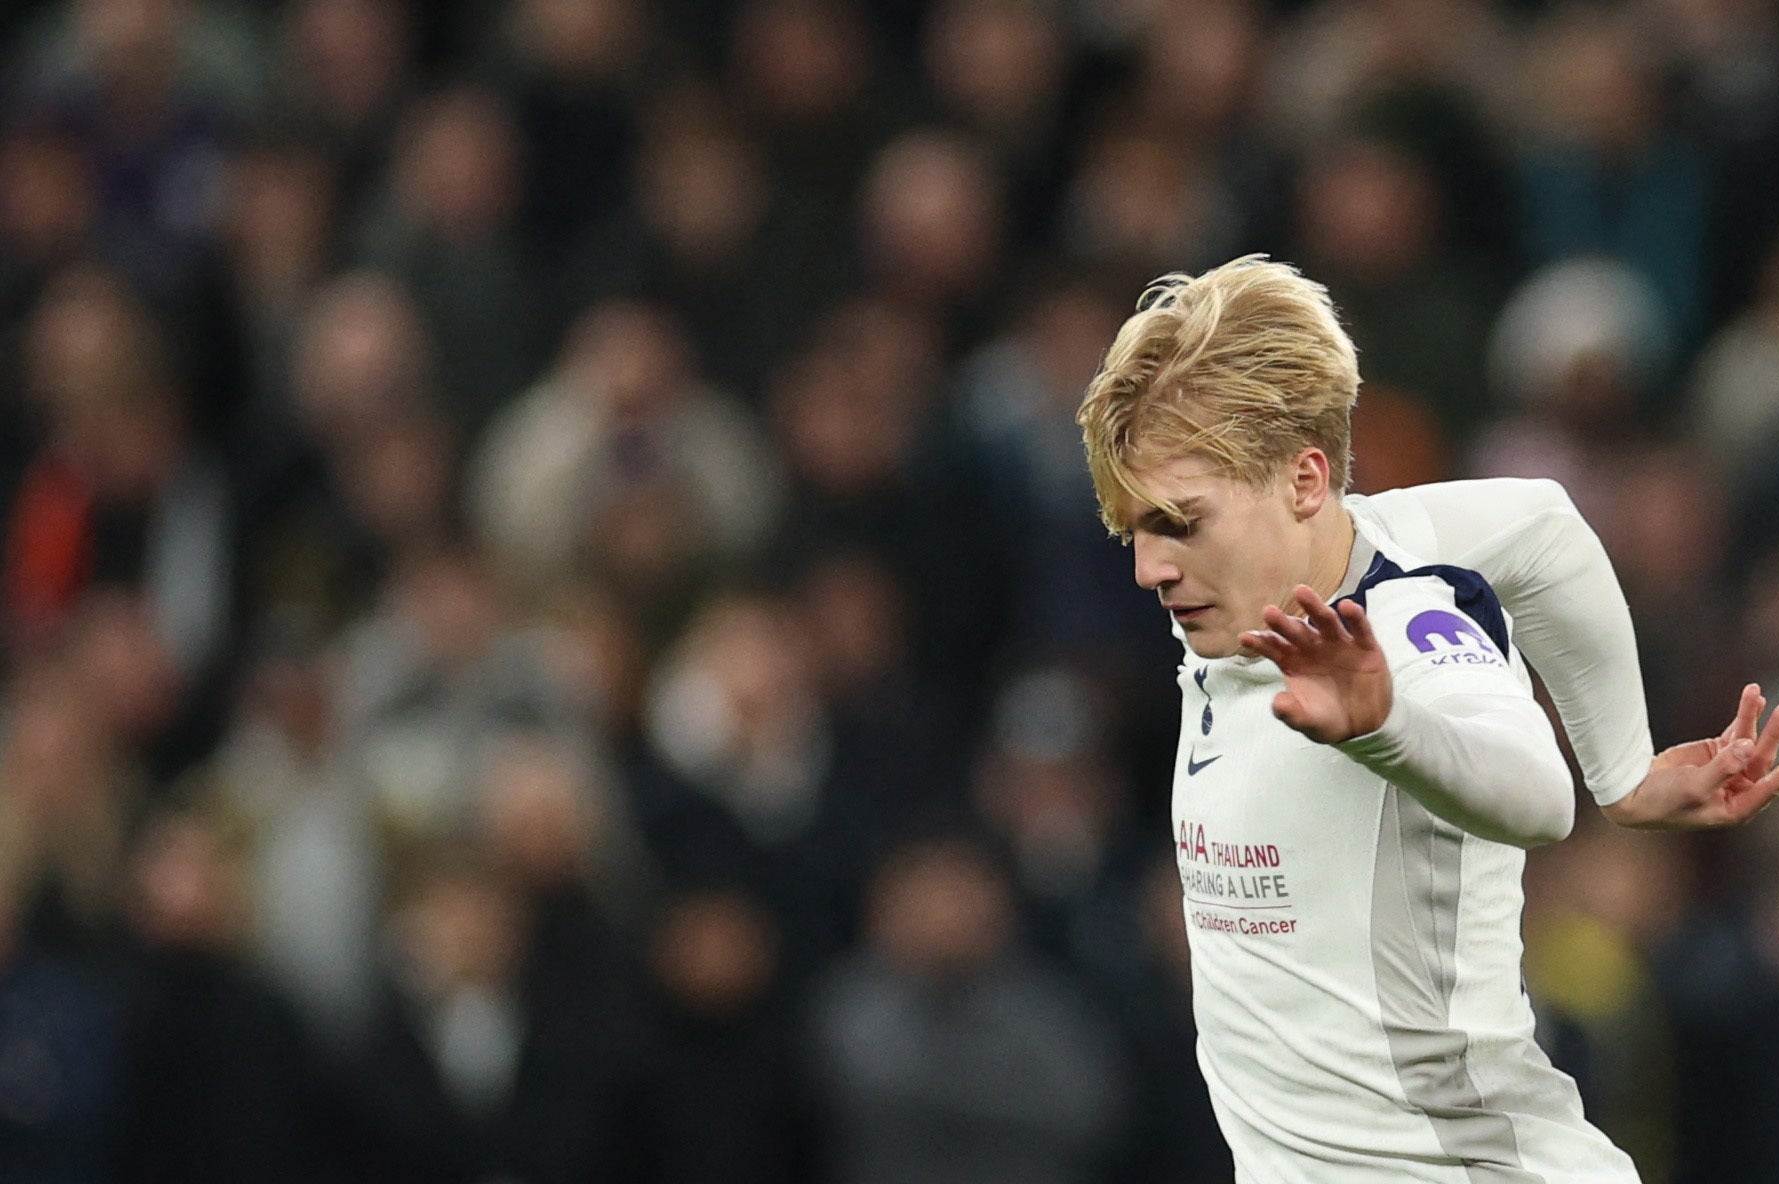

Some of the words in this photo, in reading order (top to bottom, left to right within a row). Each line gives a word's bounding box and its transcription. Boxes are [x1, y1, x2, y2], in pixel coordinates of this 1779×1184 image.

[1179, 820, 1209, 864] AIA
[1211, 842, 1280, 868] THAILAND
[1228, 876, 1238, 898] A
[1240, 875, 1289, 898] LIFE
[1239, 917, 1297, 935] Cancer
